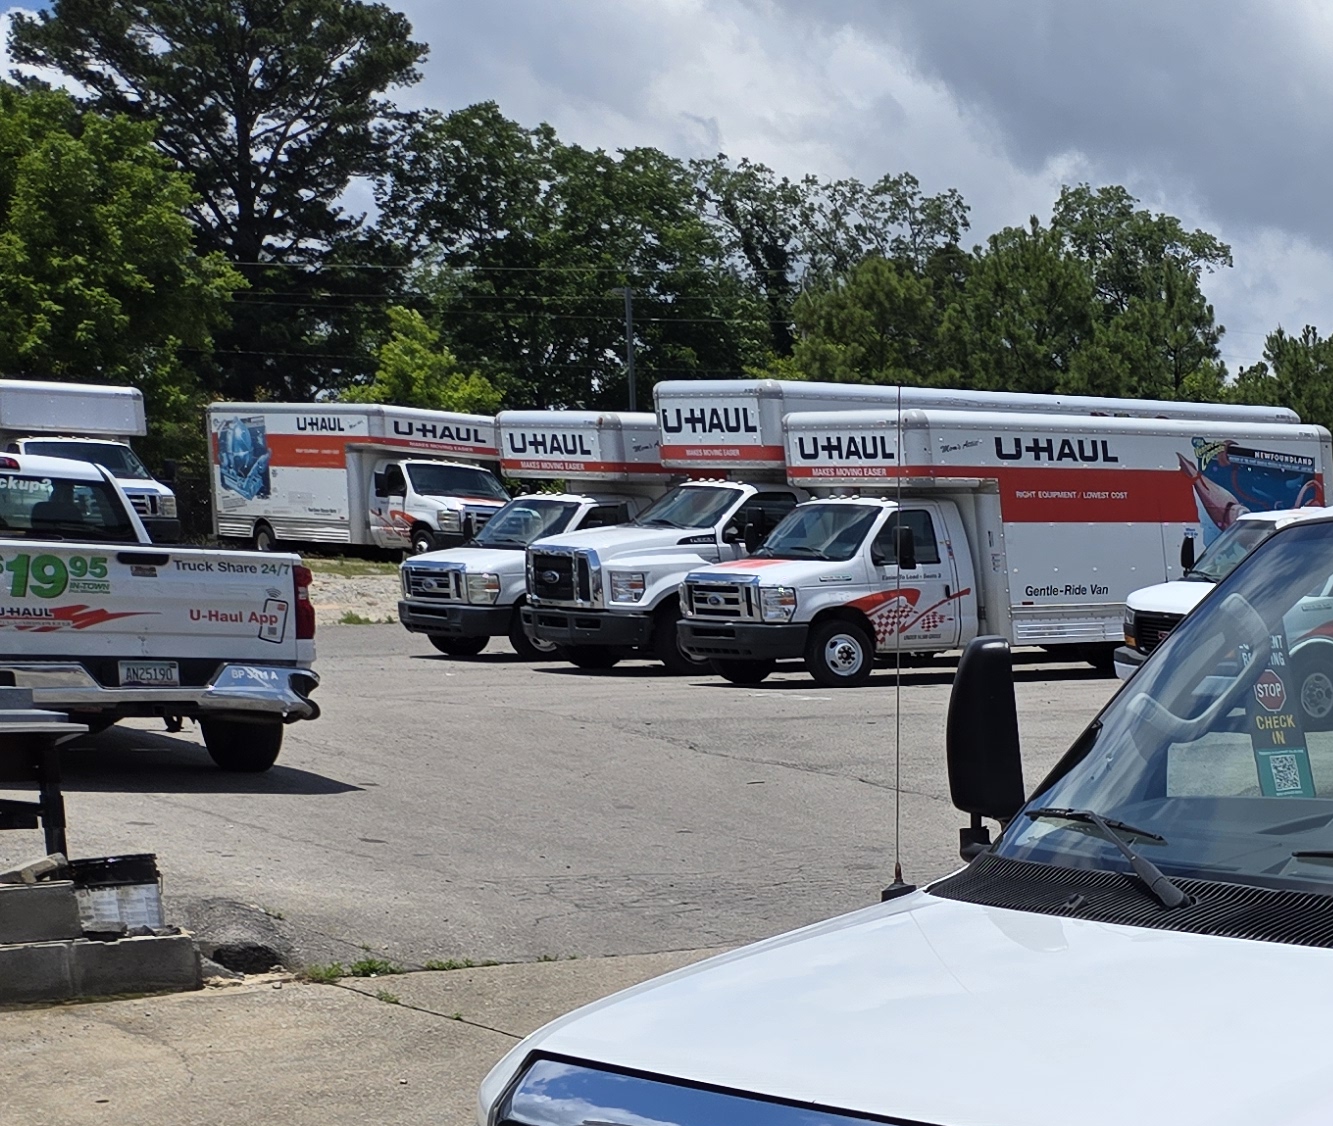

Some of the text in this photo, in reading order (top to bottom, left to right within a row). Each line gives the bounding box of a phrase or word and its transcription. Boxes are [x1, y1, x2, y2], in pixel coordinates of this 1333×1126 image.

[296, 416, 345, 432] U-HAUL
[661, 407, 758, 433] U-HAUL
[393, 420, 487, 444] U-HAUL
[509, 432, 592, 456] U-HAUL
[797, 435, 895, 460] U-HAUL
[994, 436, 1119, 463] U-HAUL
[520, 460, 585, 471] MAKES MOVING EASIER
[1254, 451, 1313, 466] NEWFOUNDLAND
[812, 468, 887, 477] MAKES MOVING EASIER
[1016, 491, 1036, 499] RIGHT
[1038, 491, 1077, 499] EQUIPMENT
[1083, 491, 1110, 499] LOWEST
[1111, 491, 1128, 499] COST
[172, 559, 215, 573] Truck
[217, 561, 258, 574] Share
[260, 562, 291, 576] 24/7
[1025, 584, 1109, 597] Gentle-Ride Van
[189, 609, 278, 626] U-Haul App
[125, 667, 173, 681] AN25190
[1257, 683, 1281, 698] STOP
[1256, 714, 1296, 730] CHECK
[1272, 730, 1286, 745] IN
